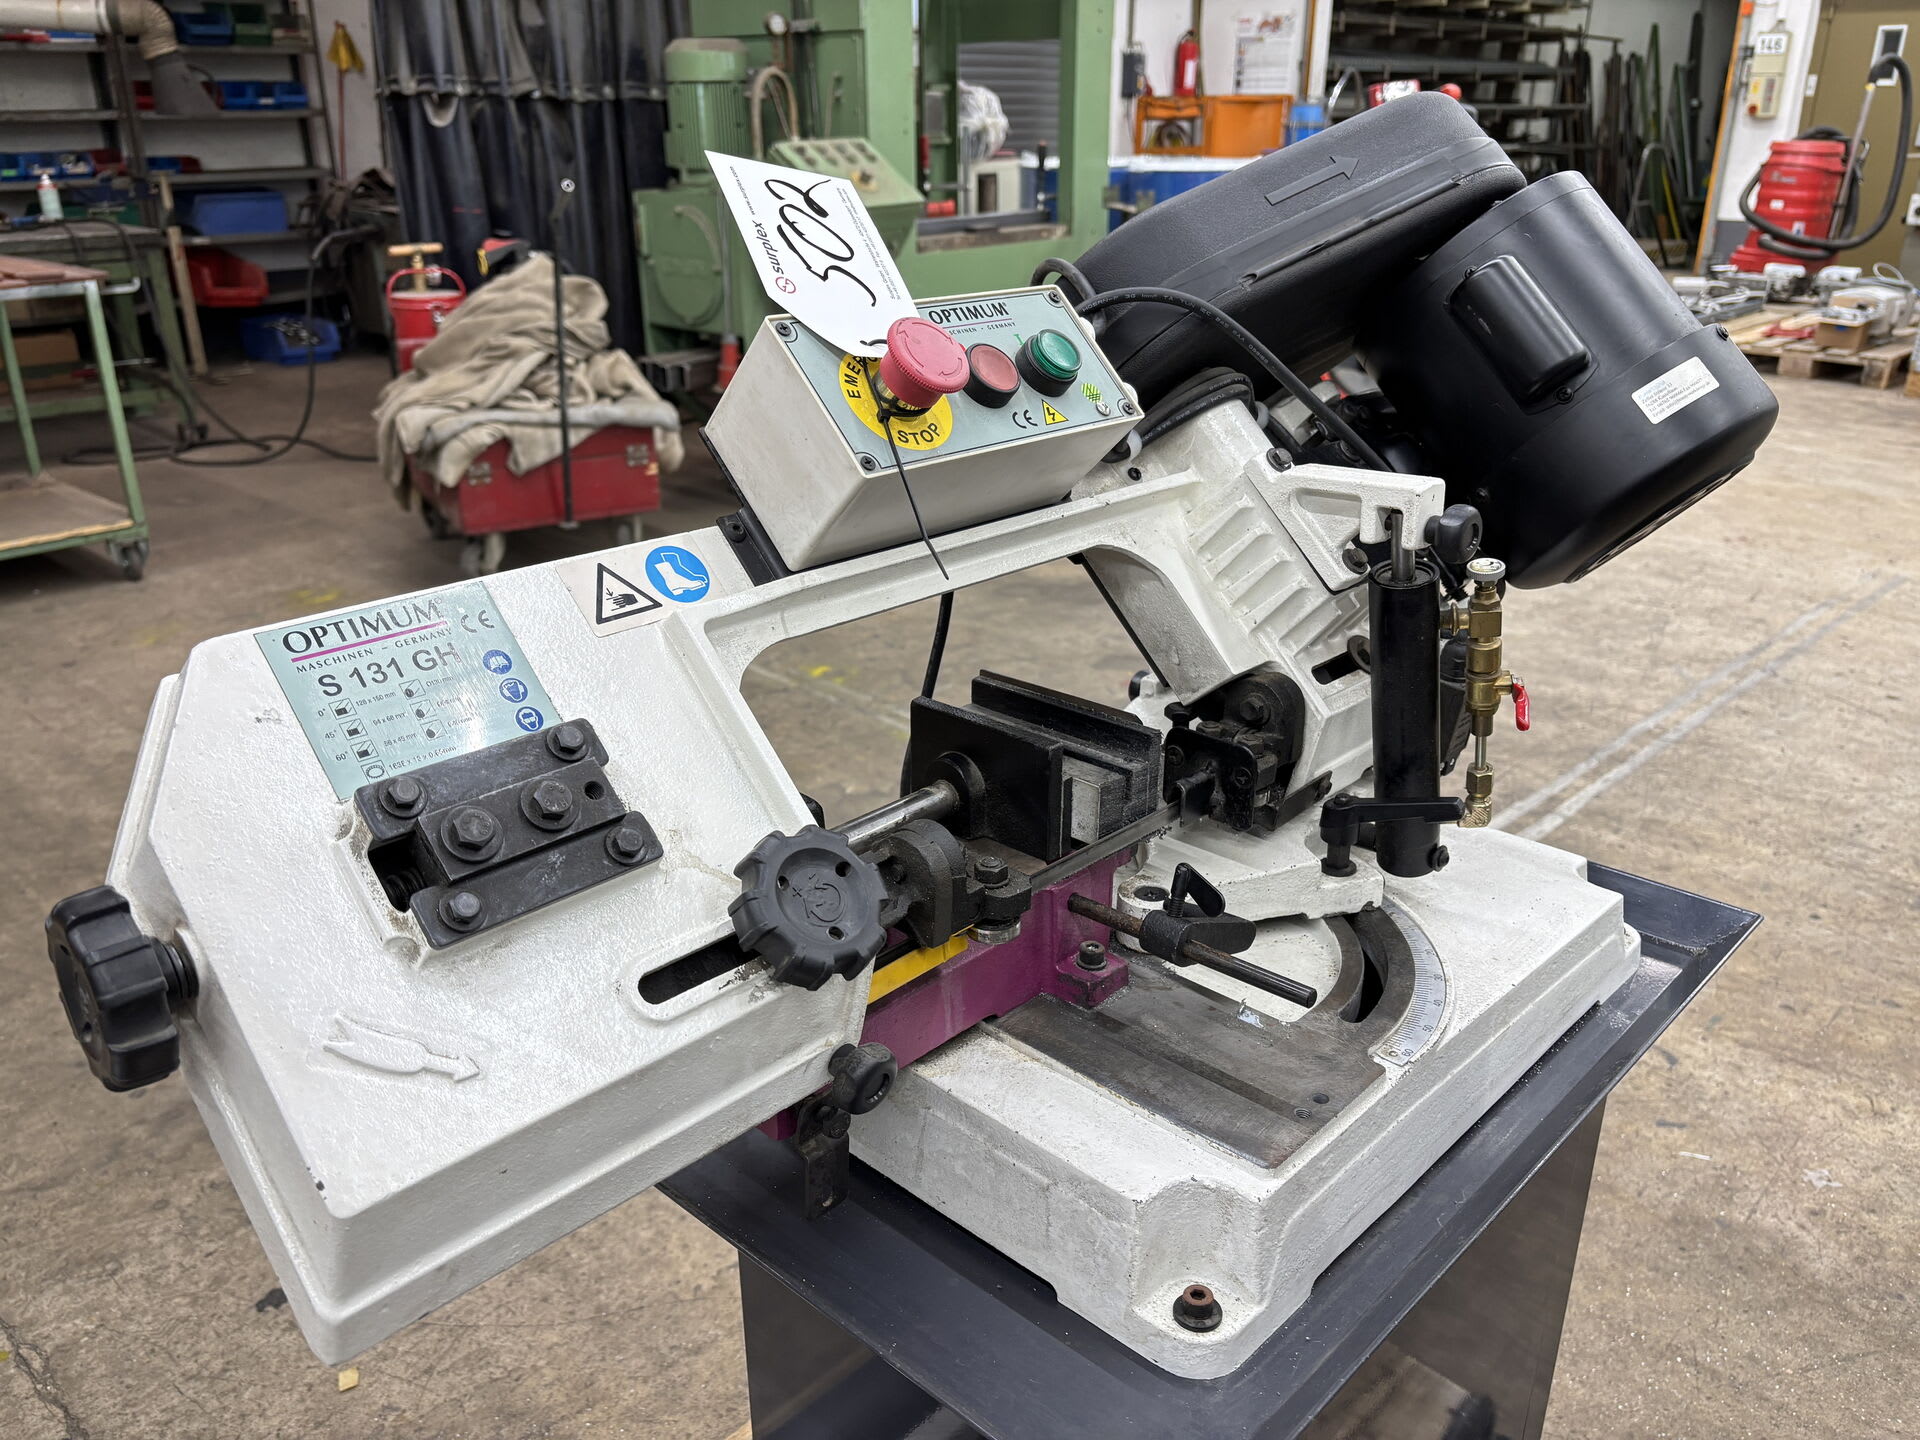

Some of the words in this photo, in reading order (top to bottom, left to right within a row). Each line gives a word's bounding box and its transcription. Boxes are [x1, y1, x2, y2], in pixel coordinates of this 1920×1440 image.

[1759, 38, 1783, 50] 146
[730, 165, 756, 215] www.surplex.com
[752, 220, 784, 275] surplex
[764, 179, 877, 307] 502
[928, 302, 1009, 325] OPTIMUM
[949, 327, 977, 336] SCHINEN
[987, 322, 1016, 330] GERMANY
[897, 423, 940, 445] STOP
[282, 601, 444, 654] OPTIMUM
[296, 648, 374, 673] MASCHINEN
[395, 628, 452, 649] GERMANY
[318, 674, 343, 697] S
[349, 657, 405, 688] 131
[412, 642, 461, 671] GH
